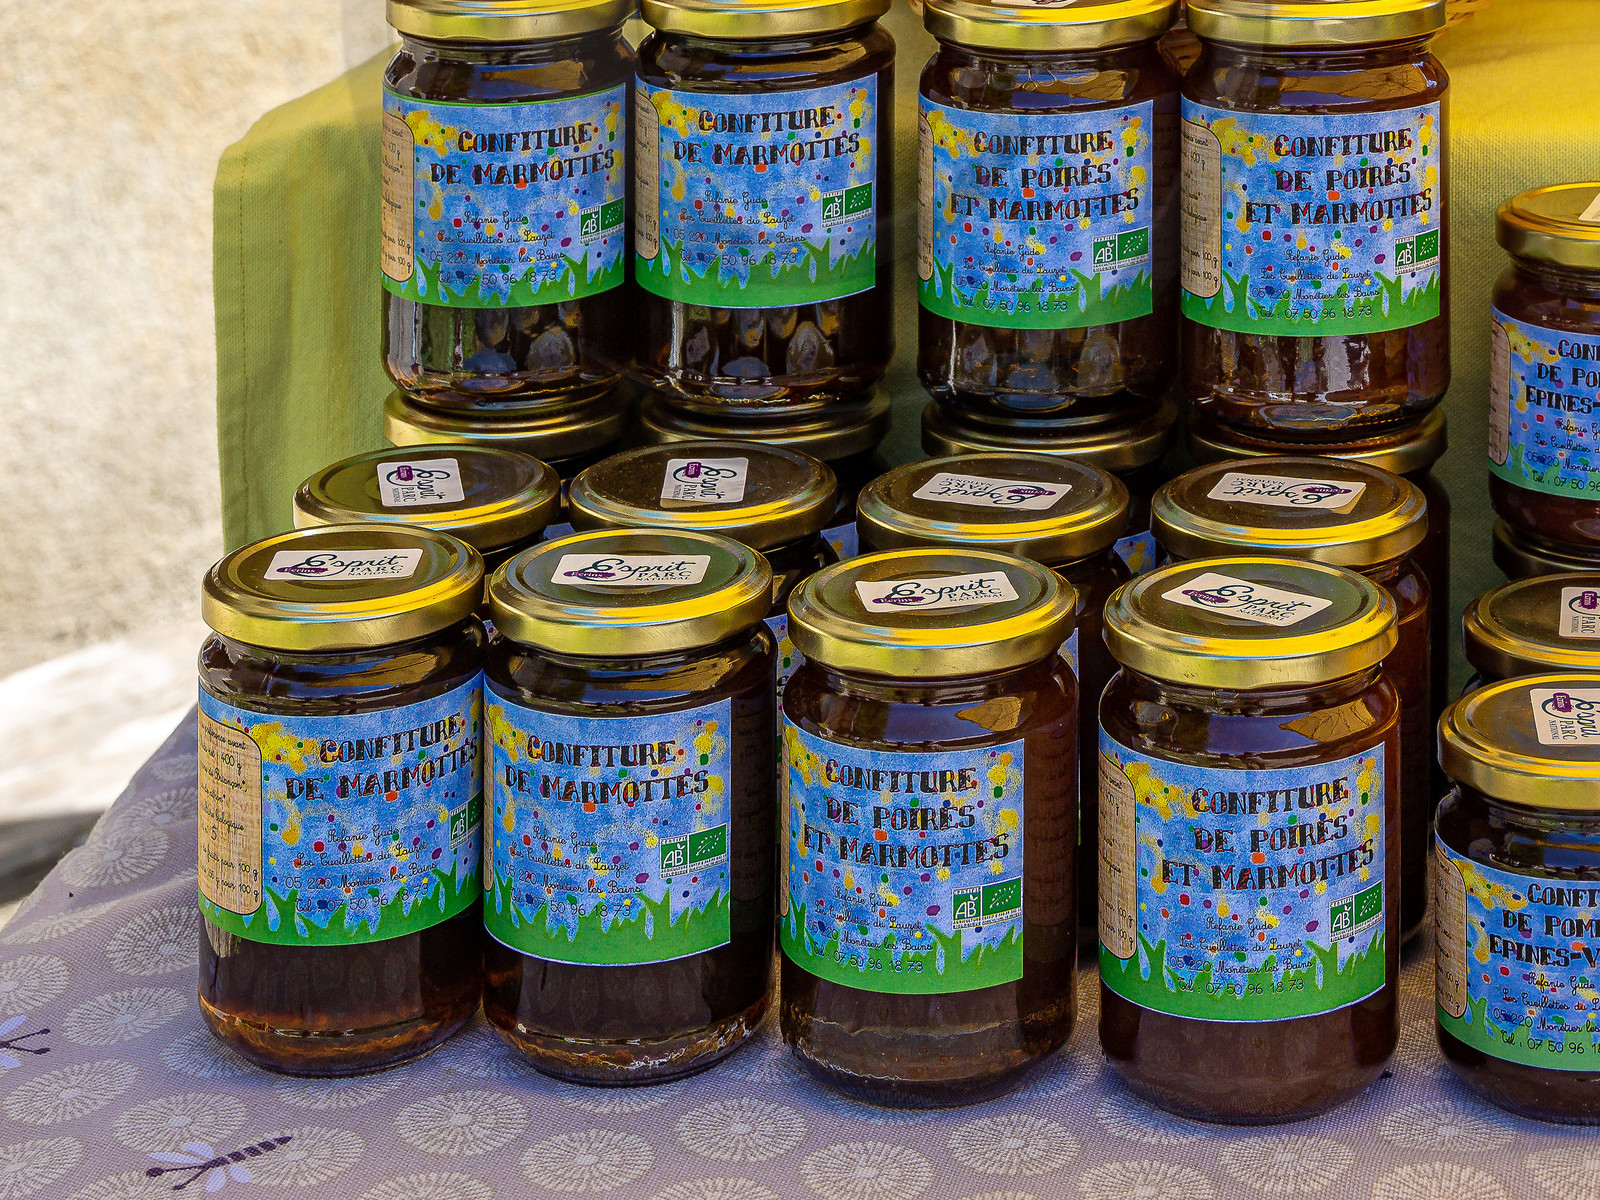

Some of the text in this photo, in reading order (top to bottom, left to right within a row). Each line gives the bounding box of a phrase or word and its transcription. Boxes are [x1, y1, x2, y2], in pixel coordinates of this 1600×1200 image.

[698, 105, 835, 133] CONFITURE
[457, 122, 592, 154] CONFITURE
[673, 132, 861, 166] DE MARMOTTES
[973, 130, 1112, 156] CONFITURE
[1273, 128, 1412, 158] CONFITURE
[430, 148, 615, 186] DE MARMOTTES
[975, 163, 1112, 189] DE POIRES
[1275, 162, 1410, 191] DE POIRES
[823, 202, 841, 219] AB
[950, 188, 1139, 221] ET MARMOTTES
[1246, 188, 1432, 225] ET MARMOTTES
[581, 218, 598, 236] AB
[1095, 247, 1112, 264] AB
[1397, 246, 1413, 265] AB
[1537, 362, 1600, 389] DE PO
[289, 554, 409, 578] Esprit
[350, 565, 403, 573] PARC
[575, 558, 696, 582] Esprit
[885, 578, 995, 606] Esprit
[948, 588, 1002, 599] PARC
[949, 593, 1005, 602] NATIONAL
[1189, 585, 1311, 612] Esprit
[1236, 609, 1285, 622] NATIONAL
[1243, 605, 1295, 618] PARC
[319, 712, 461, 763] CONFITURE
[1560, 720, 1577, 739] PARC
[526, 735, 676, 767] CONFITURE
[285, 738, 478, 800] DE MARMOTTES
[825, 759, 977, 793] CONFITURE
[504, 764, 709, 805] DE MARMOTTES
[1191, 777, 1349, 815] CONFITURE
[826, 796, 975, 831] DE POIRES
[1193, 814, 1348, 853] DE POIRES
[297, 853, 315, 867] Les
[378, 851, 391, 860] du
[395, 841, 427, 860] Lauzet
[663, 850, 684, 868] AB
[803, 824, 1010, 870] ET MARMOTTES
[285, 877, 302, 889] 05
[307, 877, 333, 890] 220
[390, 870, 405, 881] les
[408, 862, 437, 877] Bains
[575, 862, 589, 870] du
[593, 857, 630, 878] Lauzet
[1162, 838, 1374, 890] ET MARMOTTES
[326, 883, 429, 912] 07 50 96 18 73
[607, 879, 643, 894] Bains
[1527, 883, 1600, 907] CONFI
[955, 900, 977, 919] AB
[1332, 911, 1350, 932] AB
[1502, 909, 1532, 933] DE
[1179, 935, 1303, 955] Les Cueillettes du Lauzet
[1169, 956, 1184, 968] 05
[1188, 959, 1212, 972] 220
[1264, 961, 1280, 973] les
[1283, 958, 1314, 971] Bains
[1206, 982, 1222, 995] 07
[1226, 982, 1243, 995] 50
[1247, 982, 1263, 995] 96
[1270, 981, 1285, 994] 18
[1288, 978, 1304, 991] 73
[1502, 987, 1587, 1011] Les Cueillettes du
[1493, 1008, 1508, 1022] 05
[1510, 1013, 1533, 1028] 220
[1527, 1037, 1543, 1050] 07
[1547, 1040, 1564, 1053] 50
[1568, 1042, 1584, 1055] 96
